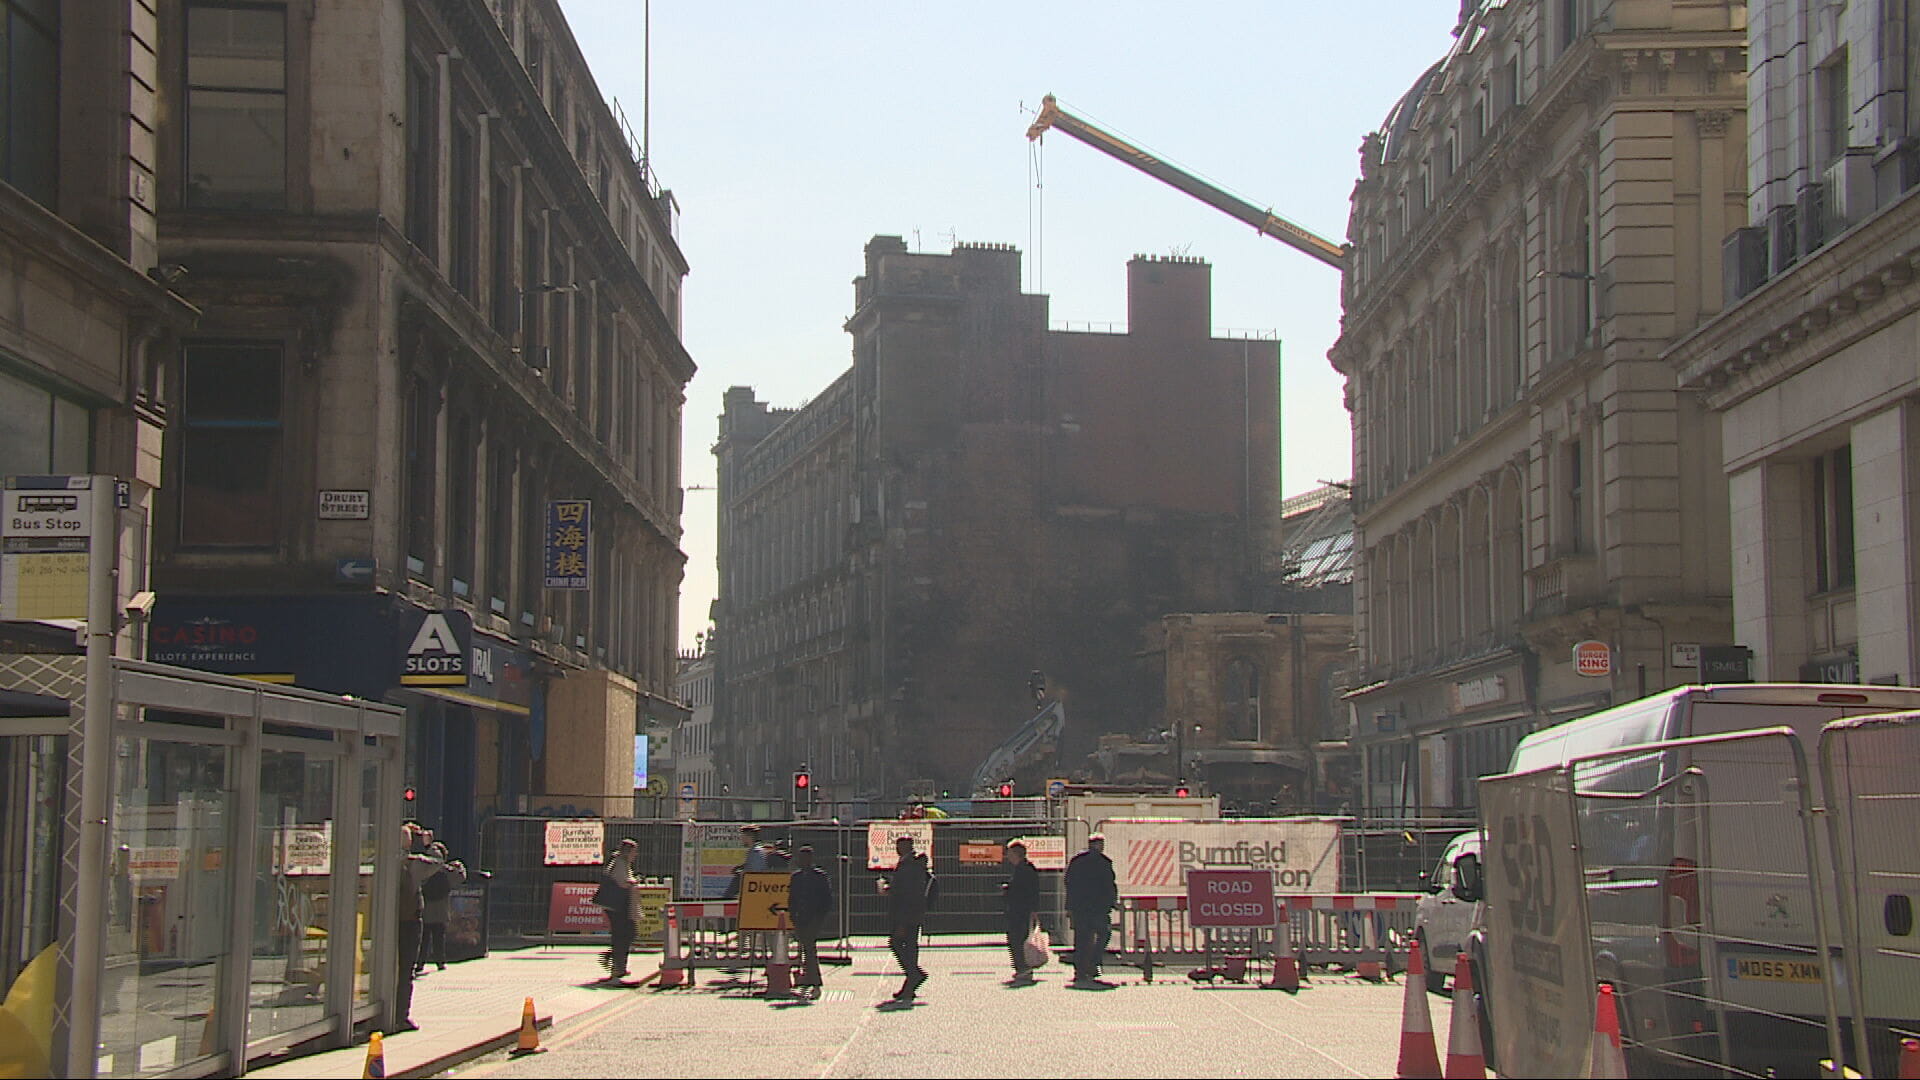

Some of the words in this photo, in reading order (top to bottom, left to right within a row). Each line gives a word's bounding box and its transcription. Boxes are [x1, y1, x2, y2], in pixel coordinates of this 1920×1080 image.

[324, 493, 363, 503] DRURY
[321, 503, 365, 513] STREET
[13, 518, 41, 530] Bus
[46, 518, 82, 532] Stop
[153, 625, 257, 644] CASINO
[407, 613, 462, 655] A
[155, 652, 186, 661] SLOTS
[191, 652, 256, 661] EXPERIENCE
[406, 657, 462, 671] SLOTS
[1578, 659, 1608, 669] KING
[1178, 840, 1287, 866] Burnfield
[1207, 880, 1253, 894] ROAD
[568, 906, 602, 914] FLYING
[1200, 902, 1264, 917] CLOSED
[564, 916, 604, 924] DRONES
